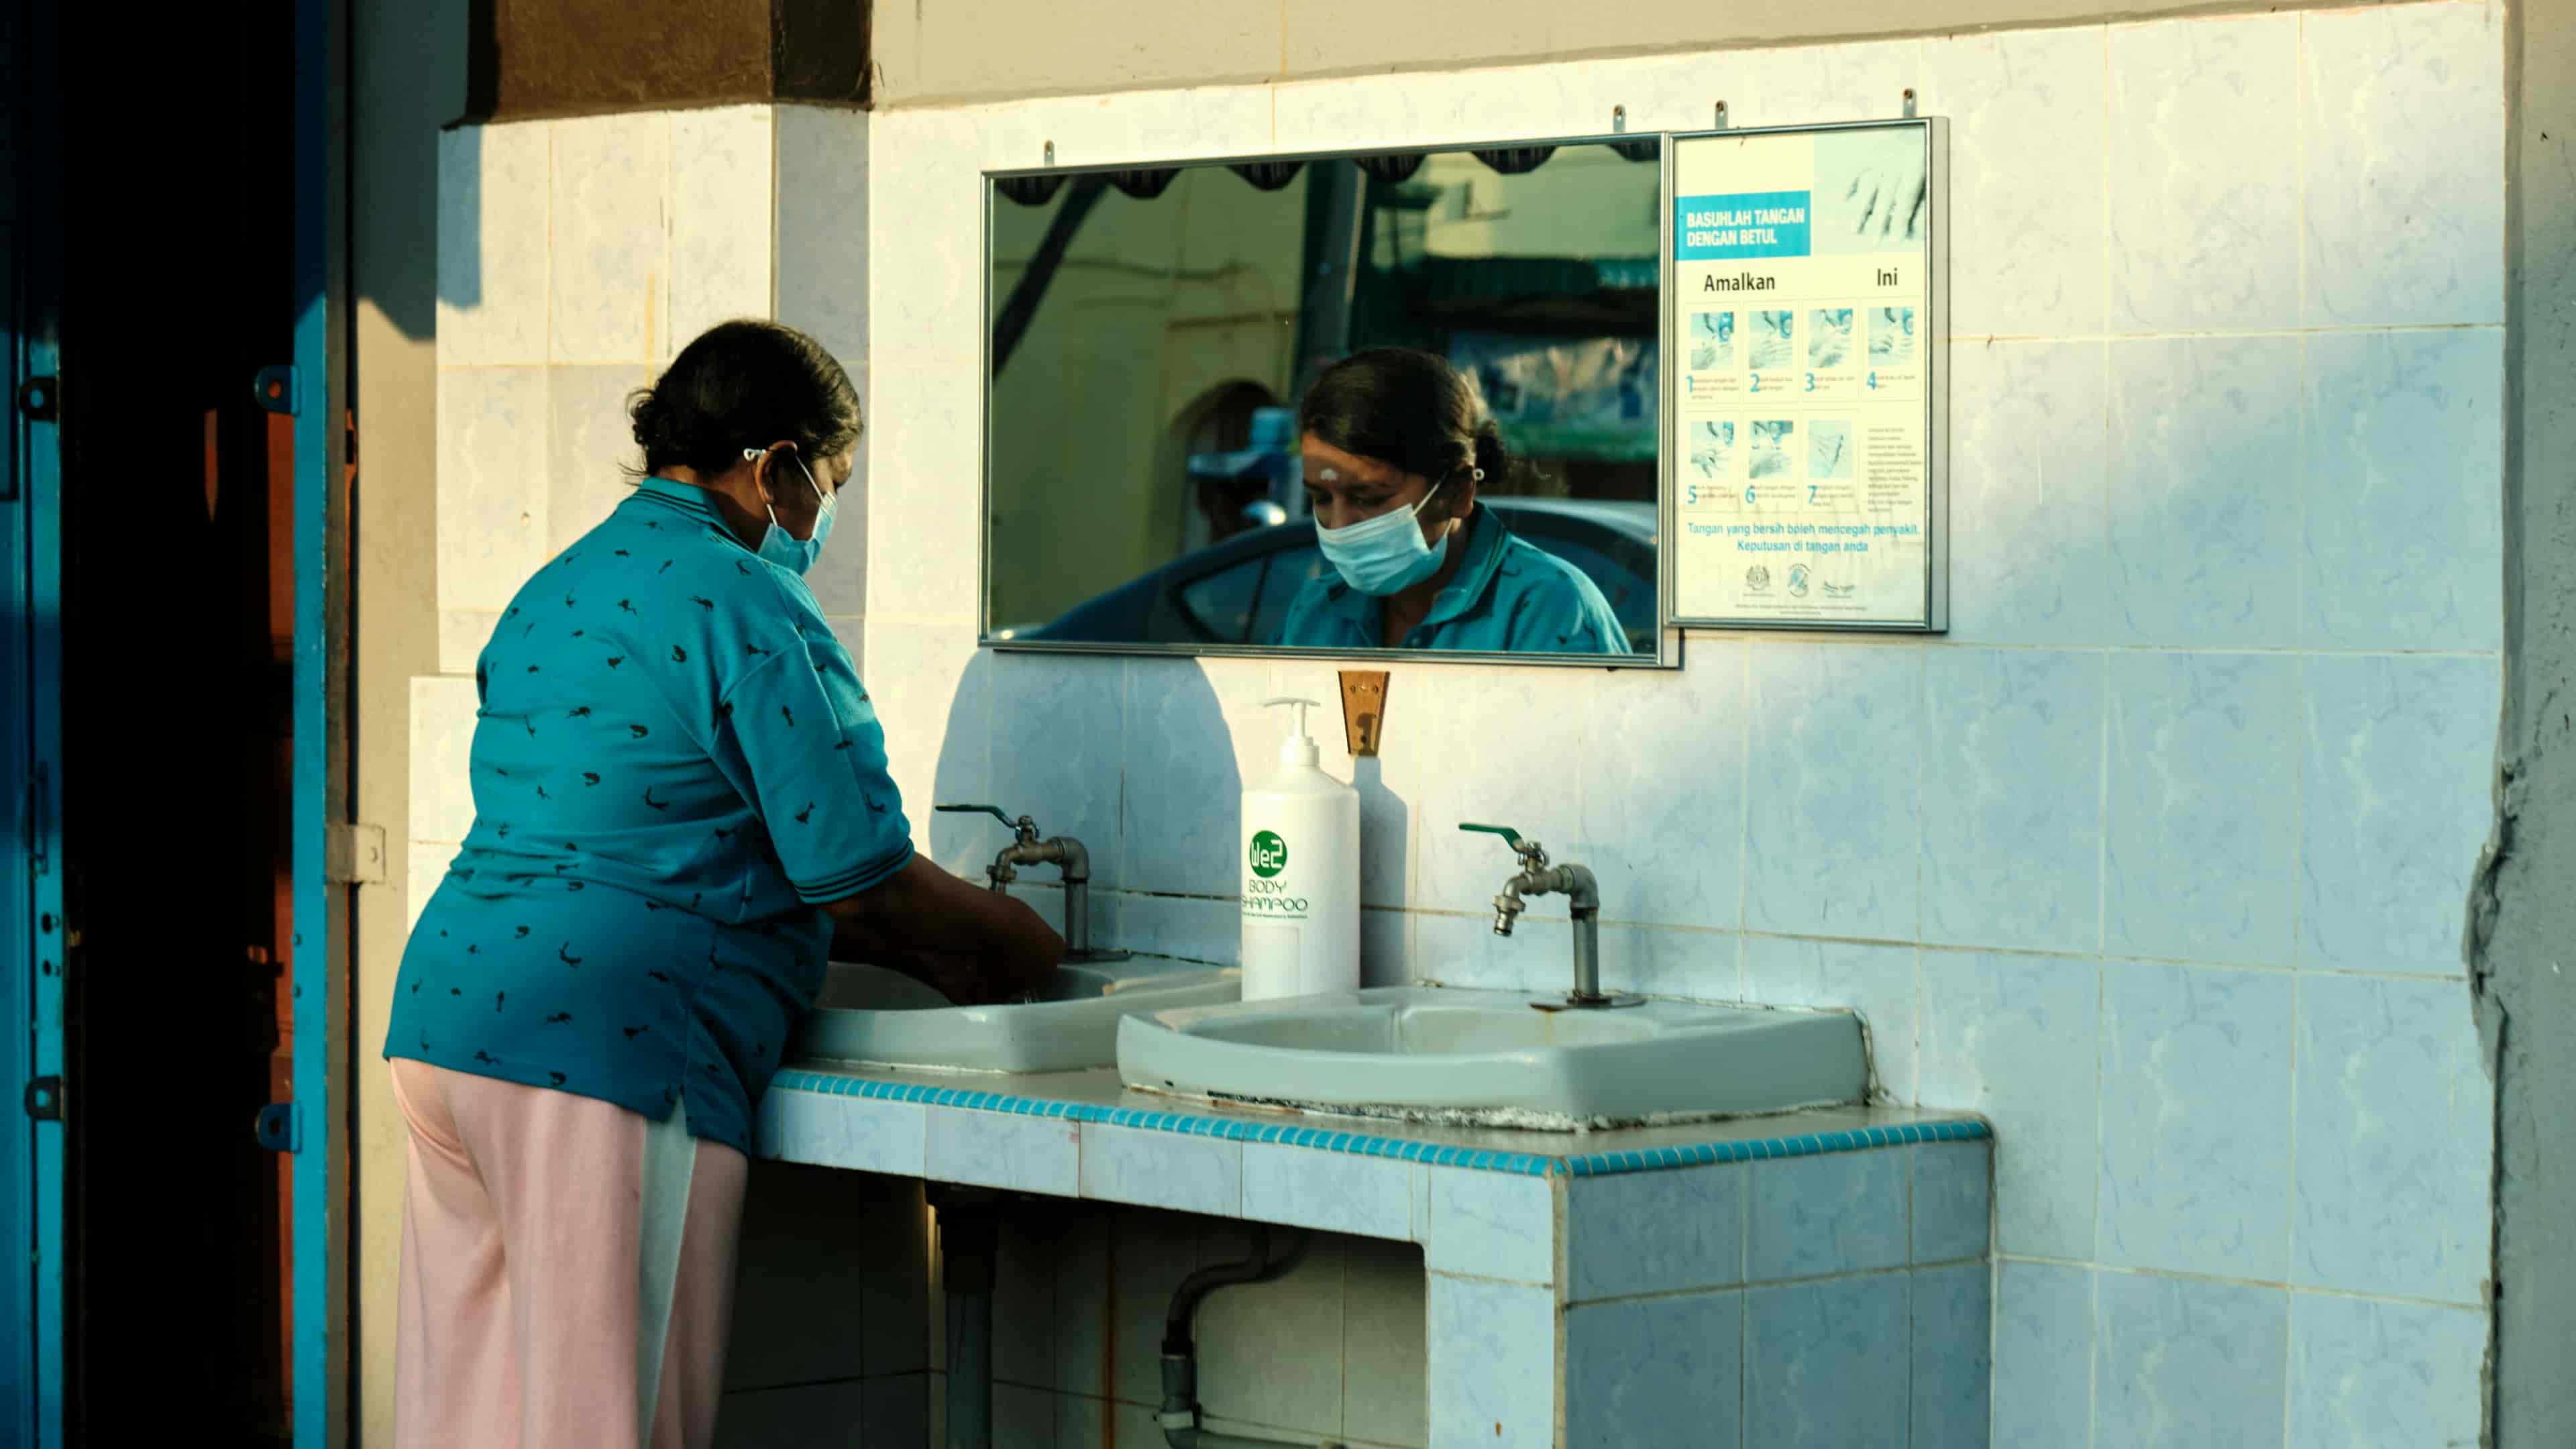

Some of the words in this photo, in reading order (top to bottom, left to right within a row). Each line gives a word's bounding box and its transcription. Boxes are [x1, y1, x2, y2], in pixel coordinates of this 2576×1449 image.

[1686, 210, 1752, 228] BASUHLAH
[1754, 207, 1805, 225] TANGAN
[1686, 230, 1737, 247] DENGAN
[1740, 228, 1777, 245] BETUL
[1703, 272, 1776, 292] Amalkan
[1877, 268, 1898, 286] Ini
[1686, 374, 1695, 393] 1
[1750, 373, 1761, 392] 2
[1805, 372, 1815, 392] 3
[1866, 371, 1878, 390] 4
[1687, 485, 1697, 504] 5
[1745, 485, 1756, 504] 6
[1807, 485, 1819, 504] 7
[1688, 523, 1723, 537] Tangan
[1726, 525, 1750, 537] yang
[1754, 523, 1784, 534] bersih
[1787, 523, 1815, 535] boleh
[1818, 524, 1870, 537] mencegah
[1737, 540, 1790, 552] Keputusan
[1793, 539, 1803, 551] di
[1806, 541, 1840, 553] tangan
[1843, 540, 1868, 551] anda
[1251, 839, 1283, 868] We2
[1250, 879, 1287, 894] BODY
